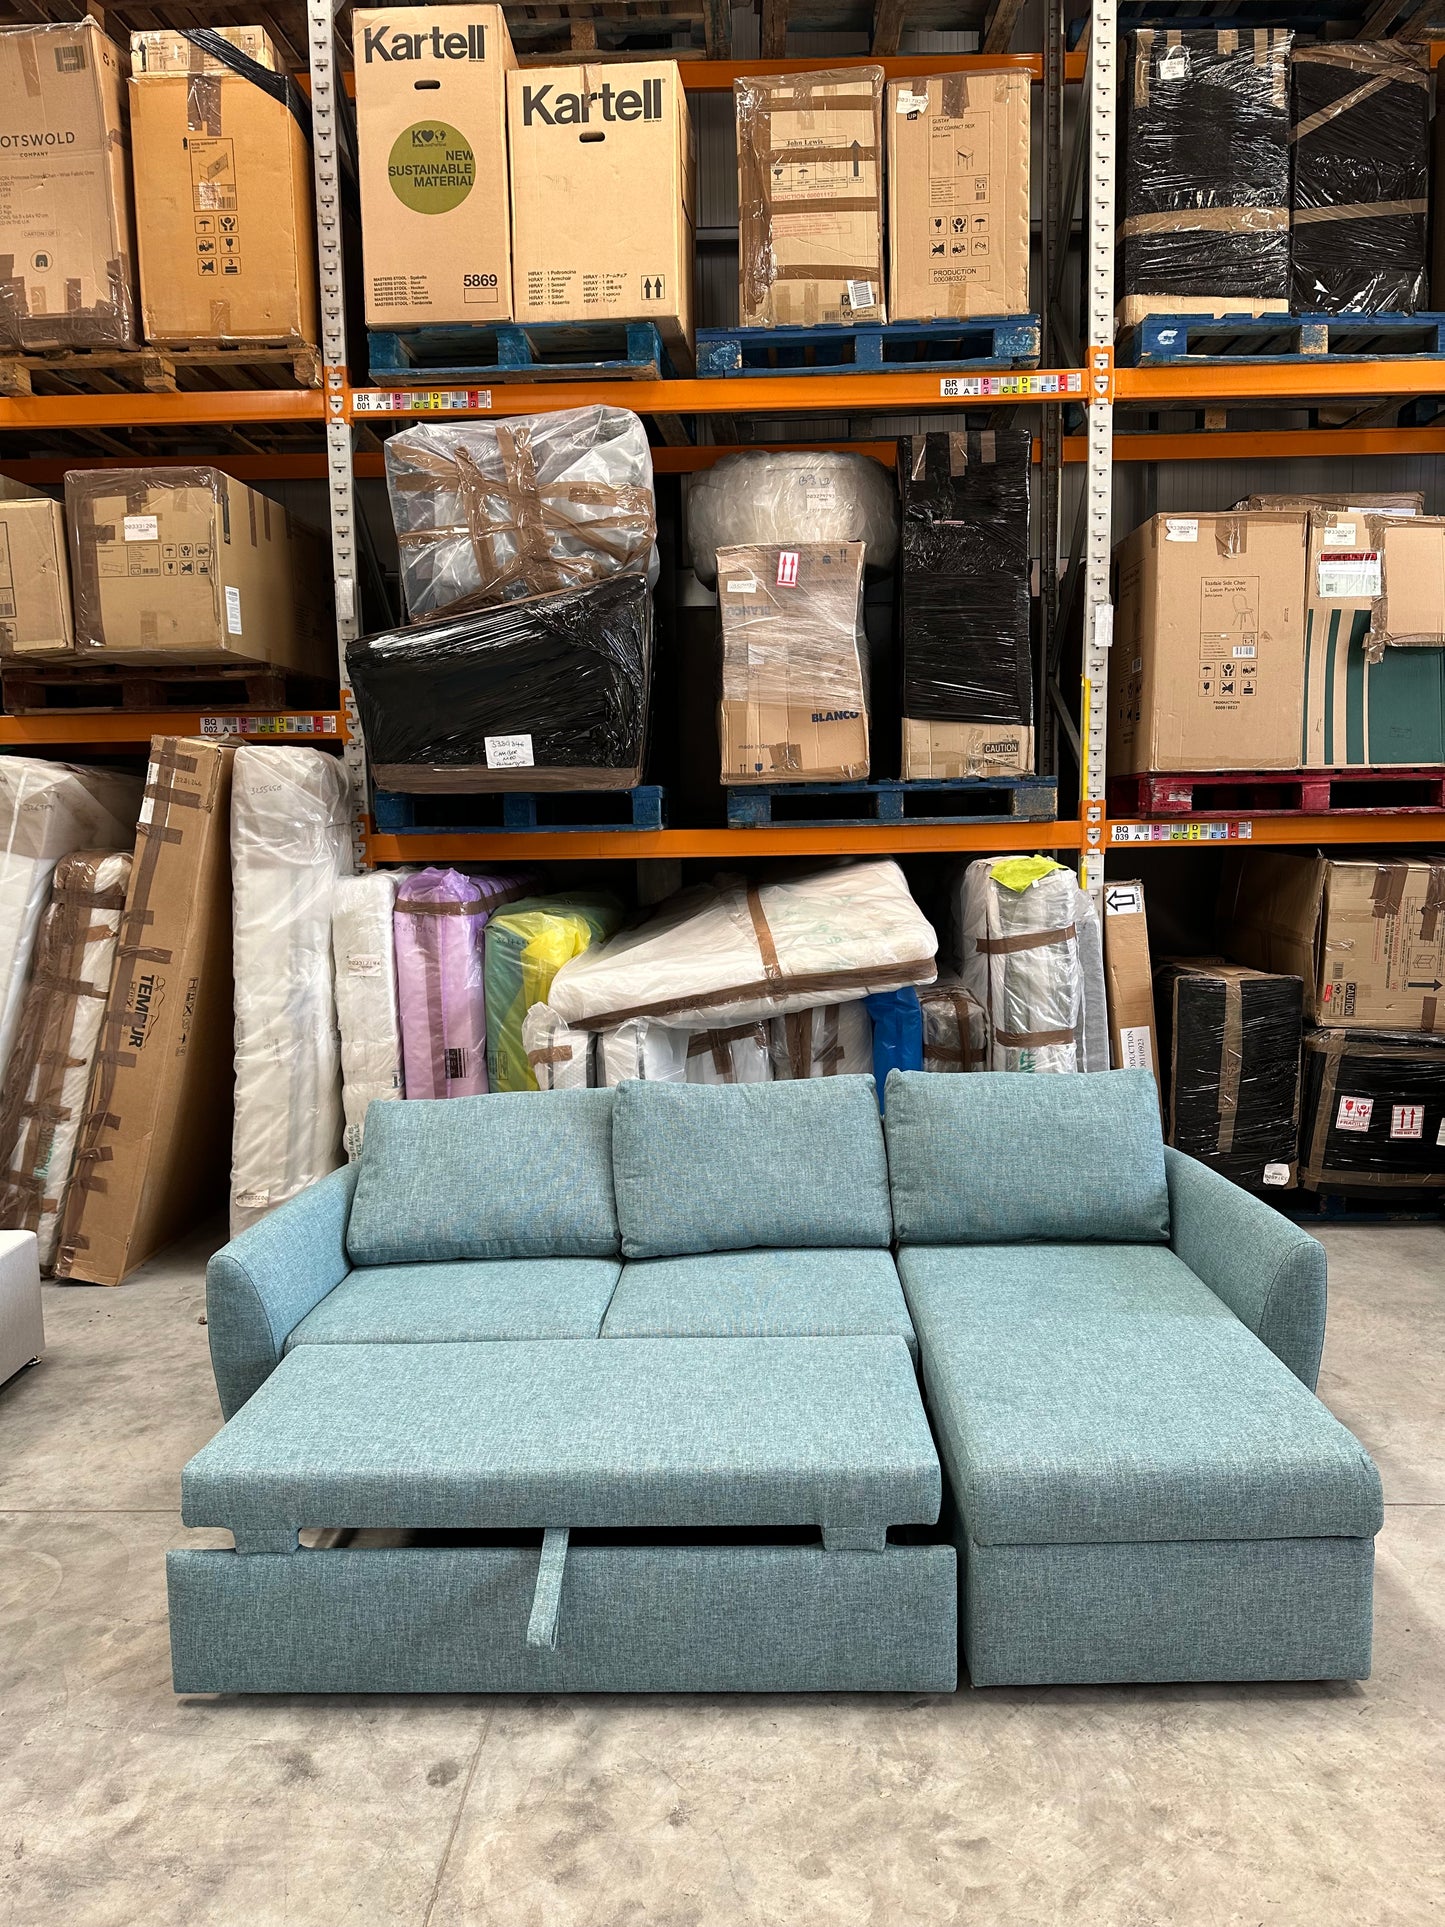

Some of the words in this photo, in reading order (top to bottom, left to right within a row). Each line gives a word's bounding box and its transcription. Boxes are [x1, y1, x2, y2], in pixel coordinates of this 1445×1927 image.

[364, 25, 485, 63] Kartell
[523, 79, 661, 126] Kartell
[0, 132, 75, 148] OTSWOLD
[446, 150, 473, 161] NEW
[388, 163, 472, 177] SUSTAINABLE
[414, 176, 473, 187] MATERIAL
[773, 192, 805, 200] ODUCTION
[934, 268, 977, 276] PRODUCTION
[463, 274, 497, 287] 5869
[812, 710, 860, 722] BLANCO
[985, 744, 1017, 752] CAUTION
[1116, 826, 1129, 834] BQ
[1345, 984, 1355, 1015] CAUTION
[129, 975, 154, 1048] TEMPUR
[1127, 1030, 1136, 1068] DUCTION
[1138, 1039, 1146, 1067] 0110923
